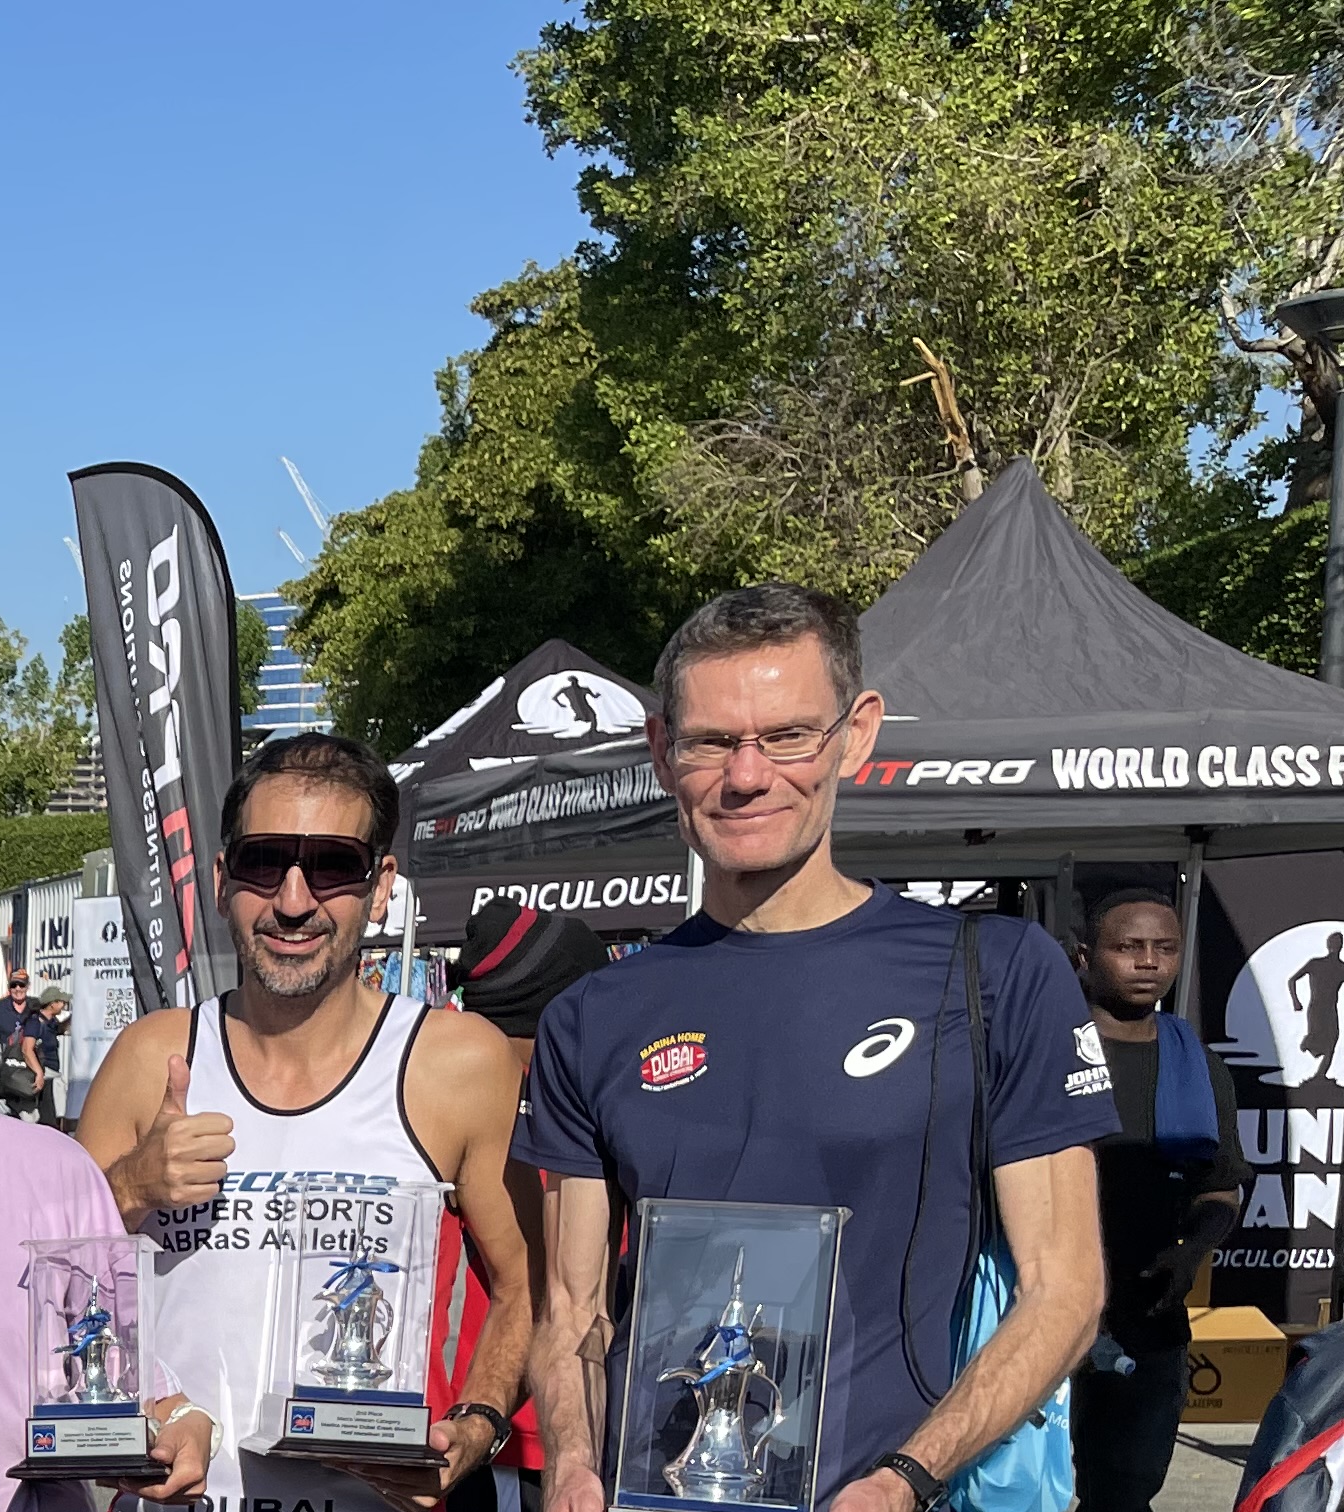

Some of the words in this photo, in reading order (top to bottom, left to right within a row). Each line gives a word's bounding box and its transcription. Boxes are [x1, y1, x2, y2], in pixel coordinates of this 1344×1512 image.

[1051, 746, 1190, 790] WORLD
[1197, 744, 1321, 788] CLASS
[526, 781, 563, 824] CLASS
[562, 772, 611, 818] FITNESS
[639, 1035, 677, 1060] MARINA
[677, 1032, 707, 1044] HOME
[650, 1045, 694, 1078] DUBAI
